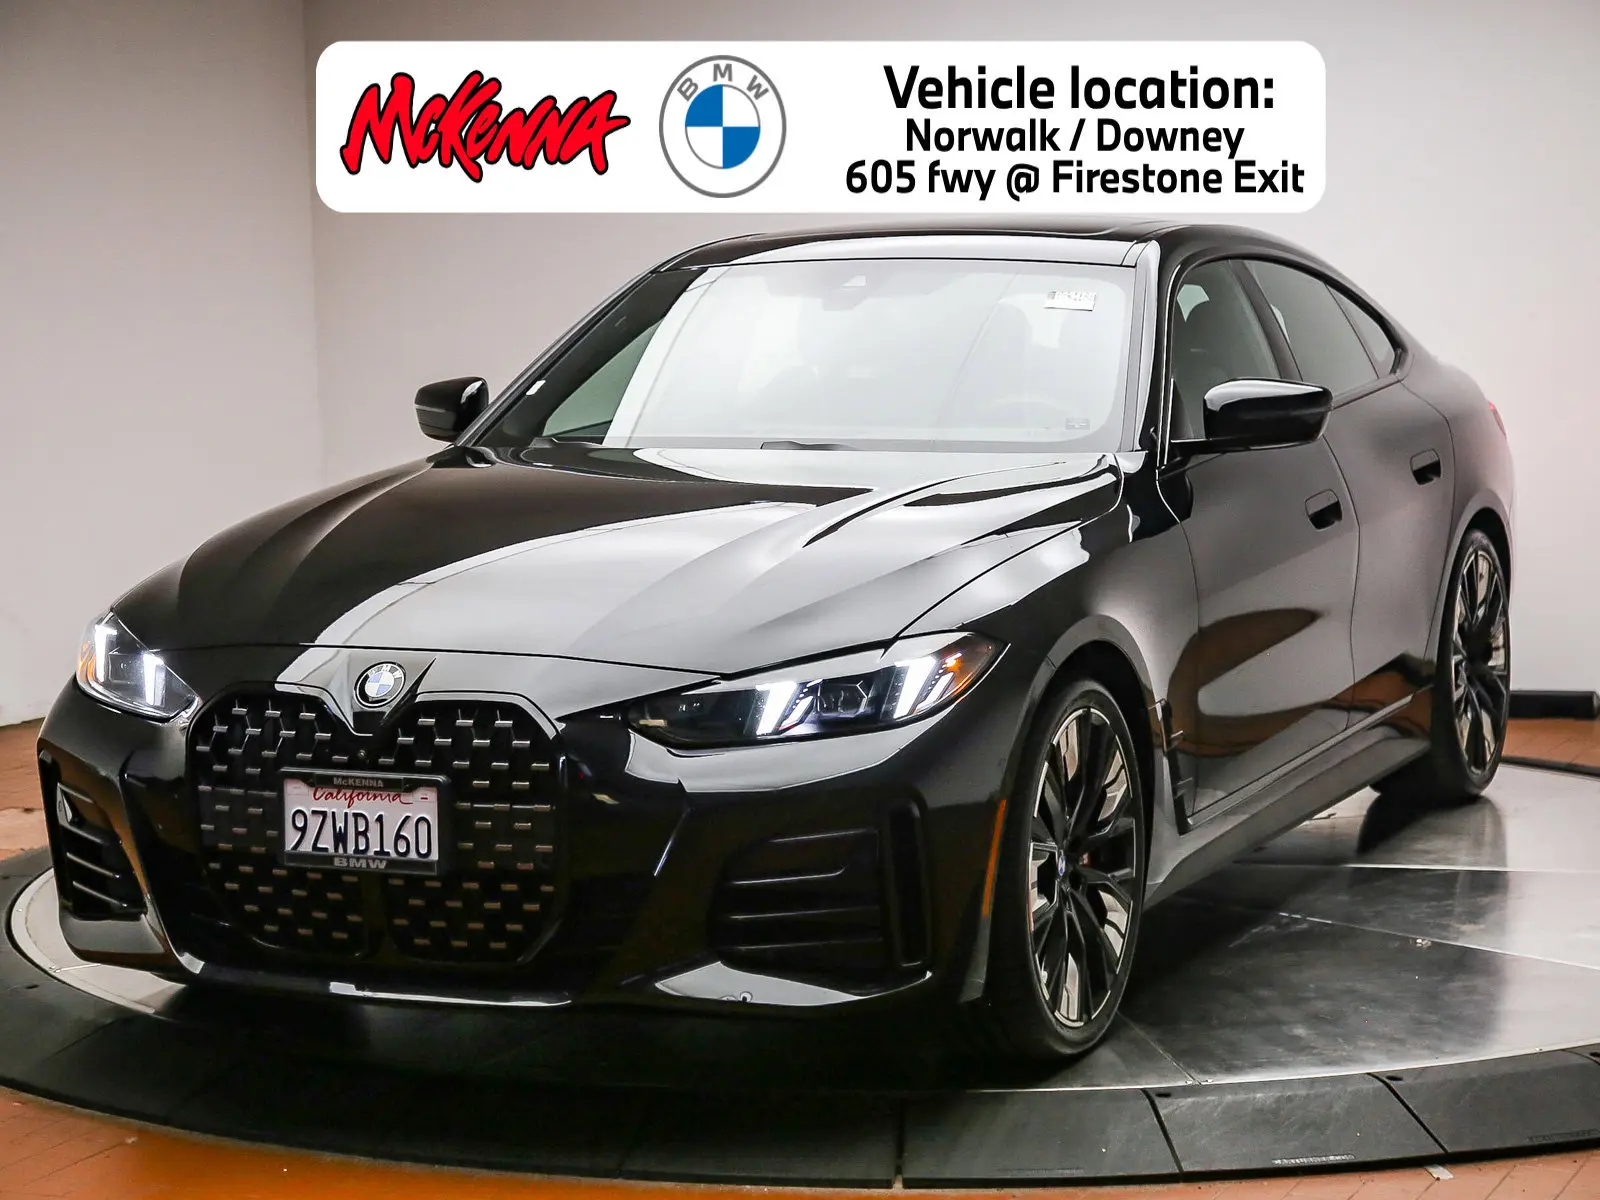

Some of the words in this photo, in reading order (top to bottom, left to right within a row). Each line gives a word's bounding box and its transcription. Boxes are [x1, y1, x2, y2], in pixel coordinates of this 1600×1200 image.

[312, 787, 413, 808] California
[291, 809, 432, 859] 9ZWB160
[334, 856, 388, 870] BMW
